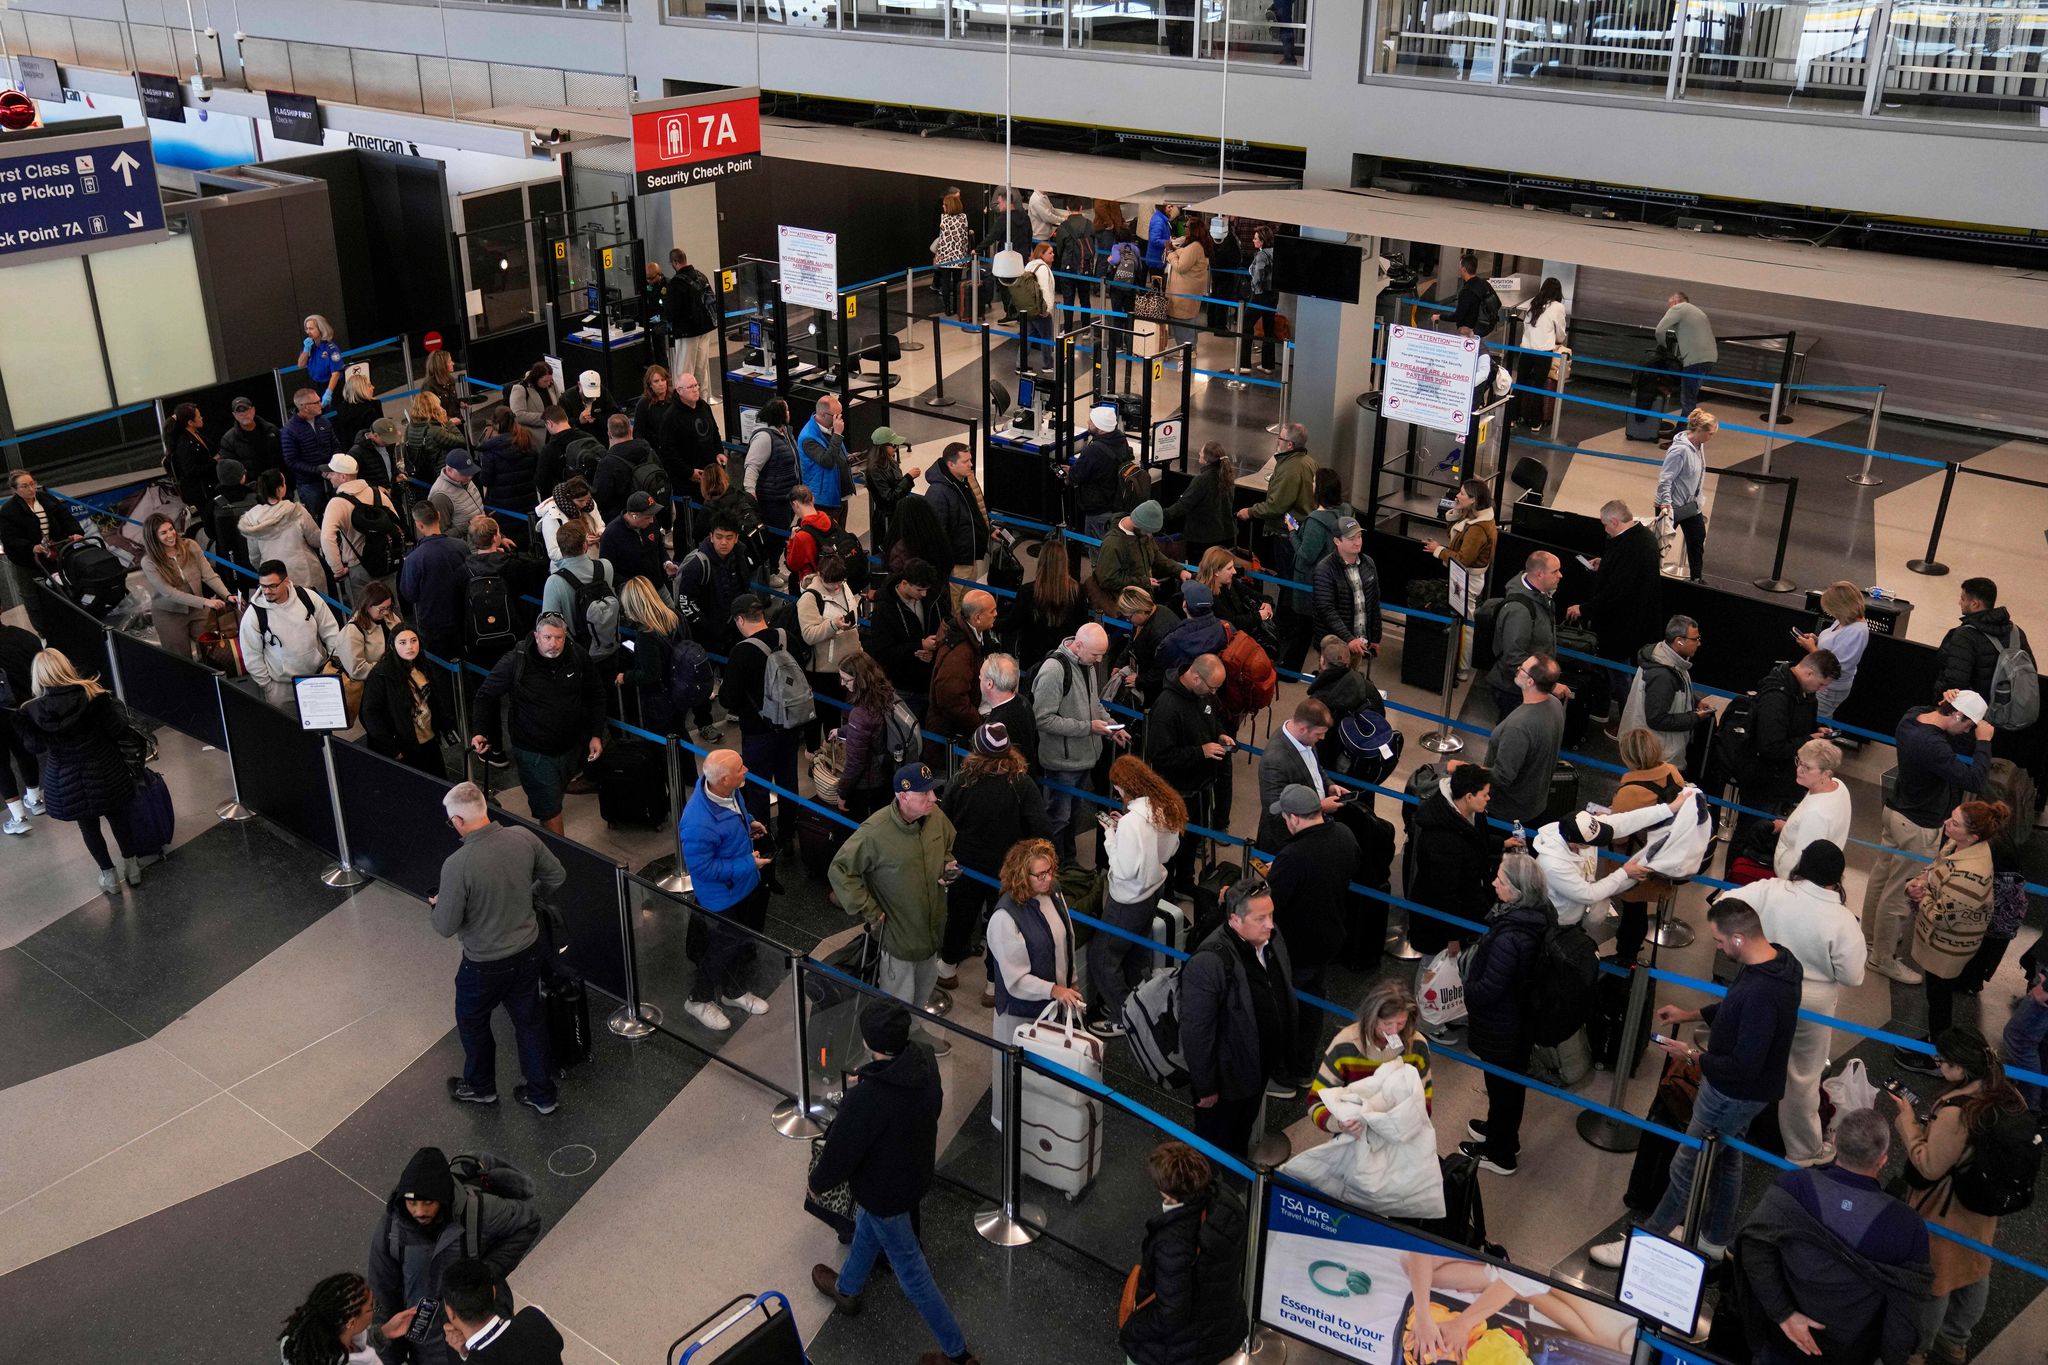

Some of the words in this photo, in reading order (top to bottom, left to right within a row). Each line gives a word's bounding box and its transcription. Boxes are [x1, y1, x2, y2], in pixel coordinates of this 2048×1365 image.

[274, 107, 298, 116] FLAGSHIP
[298, 110, 312, 119] FIRST
[698, 113, 737, 148] 7A
[348, 132, 404, 156] American
[0, 168, 22, 182] rst
[25, 164, 70, 179] Class
[647, 171, 690, 188] Security
[692, 164, 724, 180] Check
[727, 159, 752, 174] Point
[21, 184, 74, 200] Pickup
[18, 226, 60, 244] Point
[62, 222, 84, 236] 7A
[557, 244, 563, 256] 6
[604, 254, 611, 267] 6
[724, 277, 731, 290] 5
[848, 302, 854, 315] 4
[1419, 334, 1450, 344] ATTENTION
[1155, 364, 1160, 380] 2
[1400, 363, 1427, 372] FIREARMS
[1429, 368, 1439, 376] ARE
[1442, 372, 1469, 381] ALLOWED
[1435, 377, 1451, 385] POINT
[1440, 985, 1463, 1004] Webe
[1442, 999, 1463, 1010] RESTA
[1280, 1194, 1304, 1214] TSA
[1307, 1204, 1330, 1222] Pre
[1281, 1208, 1302, 1221] Travel
[1304, 1216, 1320, 1228] With
[1320, 1222, 1338, 1234] Ease
[1281, 1294, 1335, 1324] Essential
[1338, 1317, 1351, 1330] to
[1354, 1325, 1385, 1342] your
[1280, 1308, 1316, 1329] travel
[1318, 1322, 1376, 1353] checklist.
